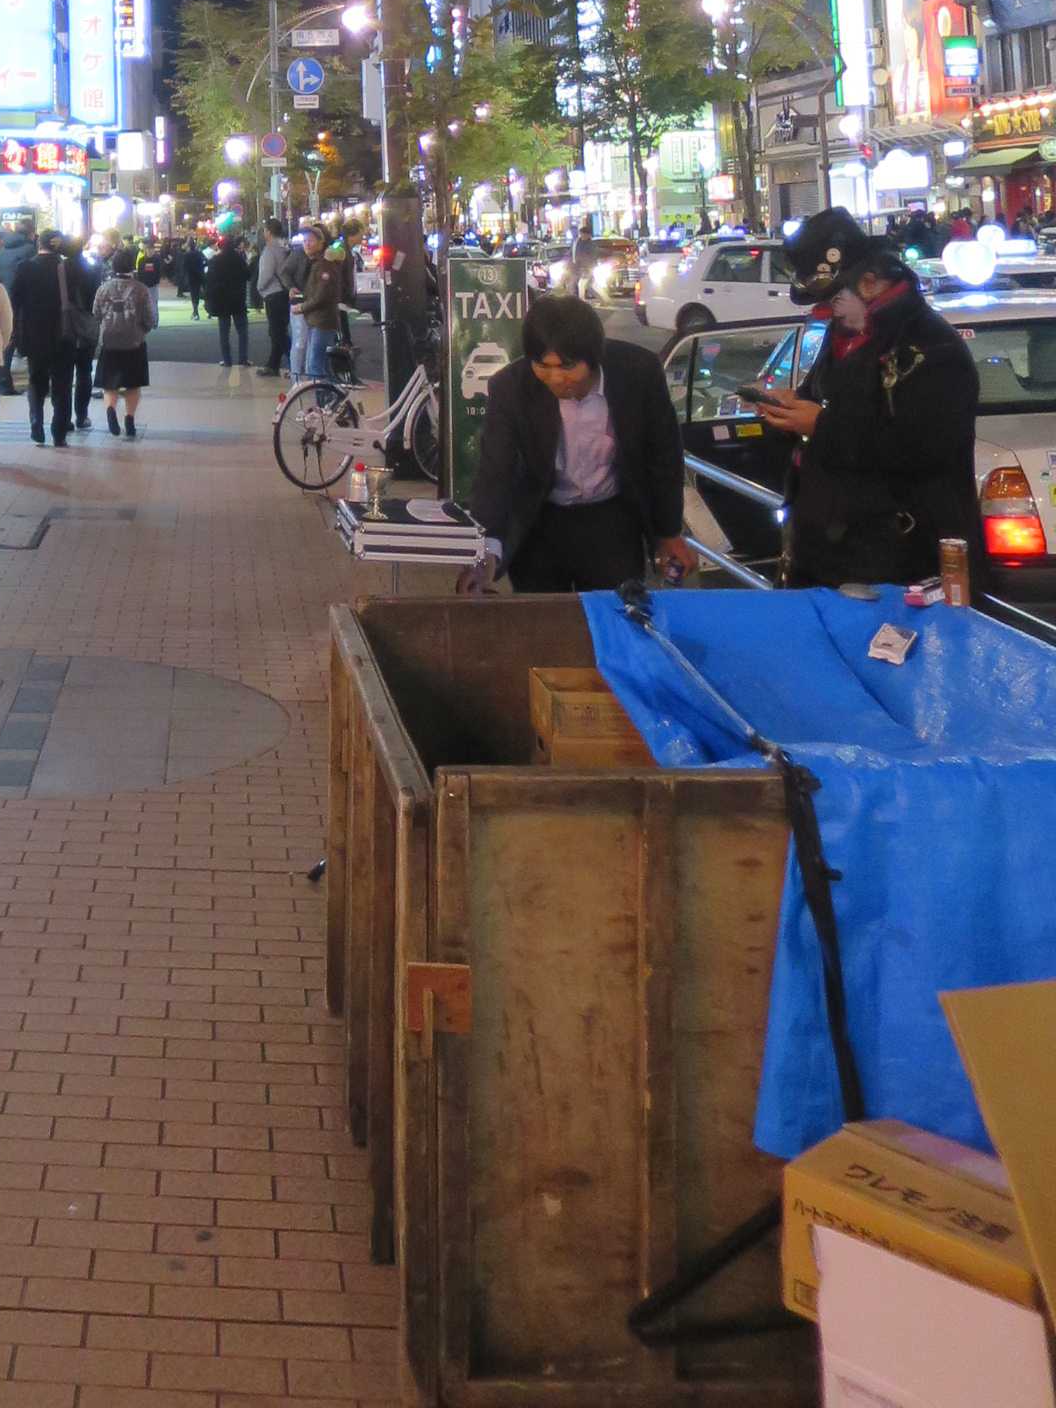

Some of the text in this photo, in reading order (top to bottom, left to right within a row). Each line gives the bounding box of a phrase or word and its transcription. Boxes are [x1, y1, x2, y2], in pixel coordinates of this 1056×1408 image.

[455, 291, 523, 321] TAXI
[845, 1163, 1014, 1244] ワレモノ注意
